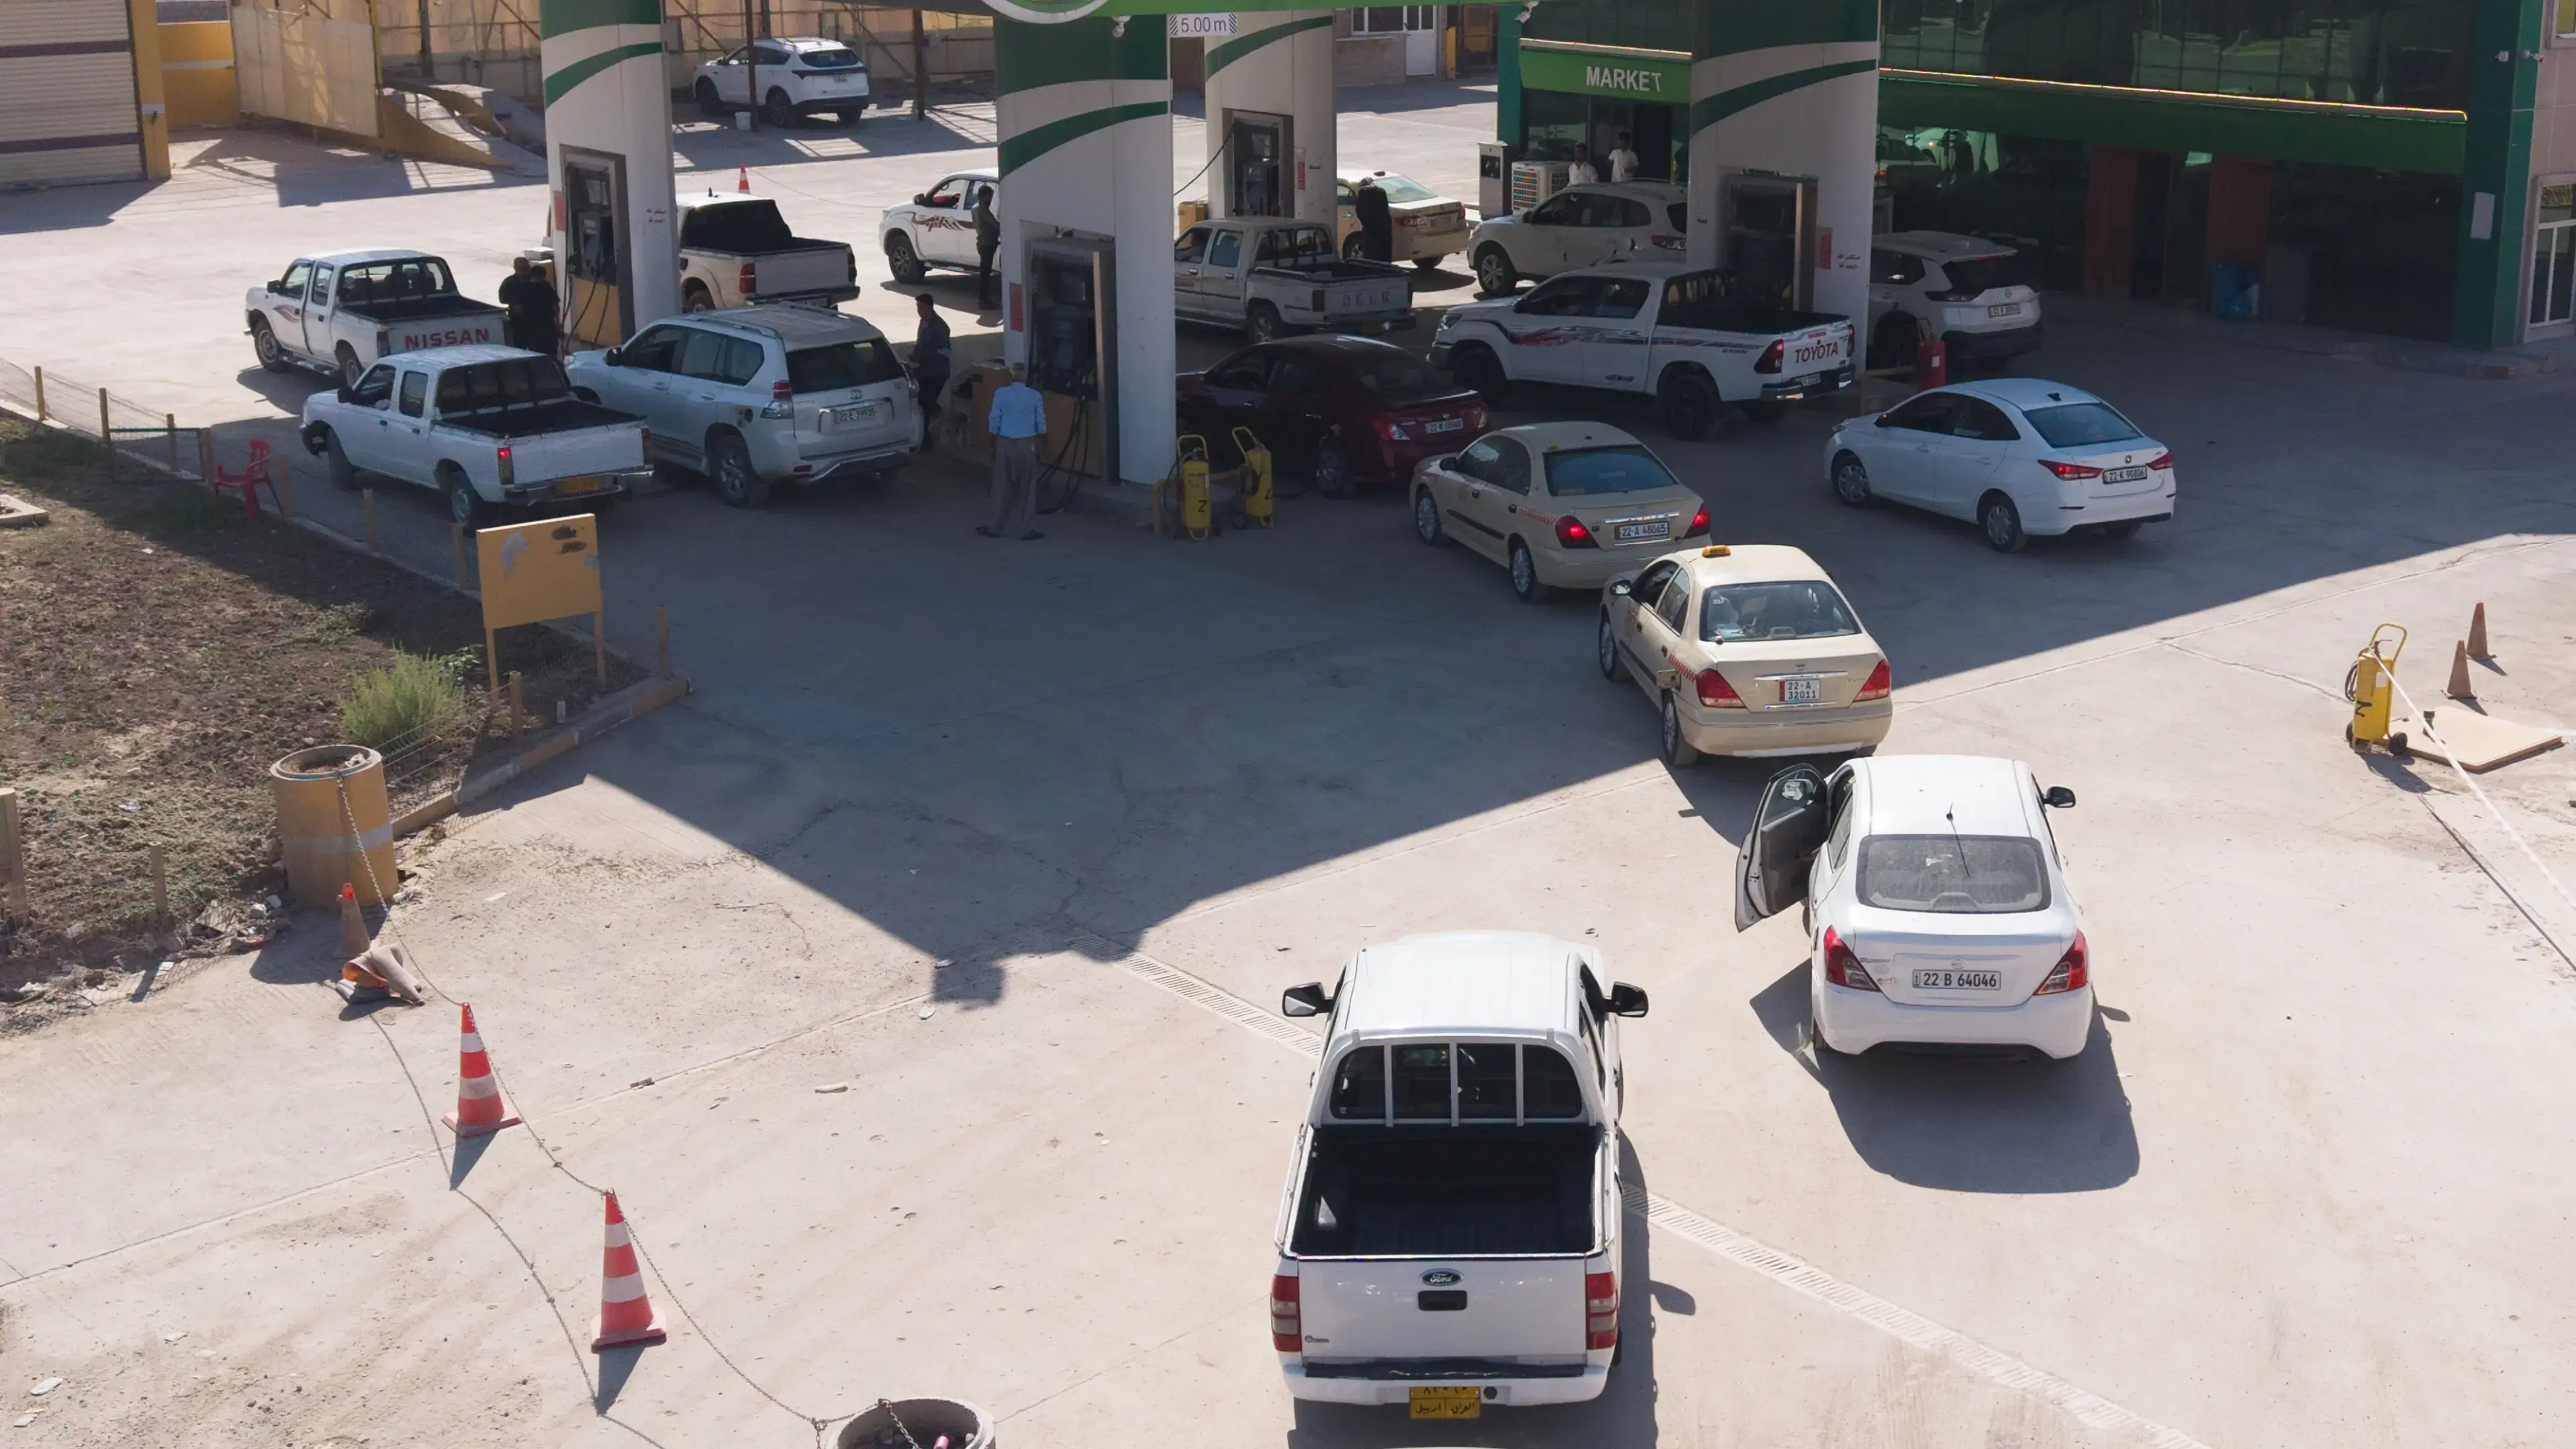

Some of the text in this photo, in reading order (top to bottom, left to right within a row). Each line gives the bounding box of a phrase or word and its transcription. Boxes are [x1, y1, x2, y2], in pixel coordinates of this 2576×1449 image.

[1181, 17, 1226, 32] 5.00 m
[1586, 66, 1662, 92] MARKET
[1342, 290, 1390, 308] DEER
[404, 327, 490, 350] NISSAN
[1794, 341, 1839, 364] TOYOTA
[2109, 472, 2117, 481] 22
[2119, 471, 2124, 479] K
[1622, 524, 1667, 537] 22 A 48065
[1788, 681, 1811, 691] 22 A
[1788, 690, 1817, 700] 32011
[1923, 972, 1939, 986] 22
[1944, 973, 1952, 987] B
[1957, 973, 1997, 987] 64046
[1430, 1273, 1454, 1283] Ford
